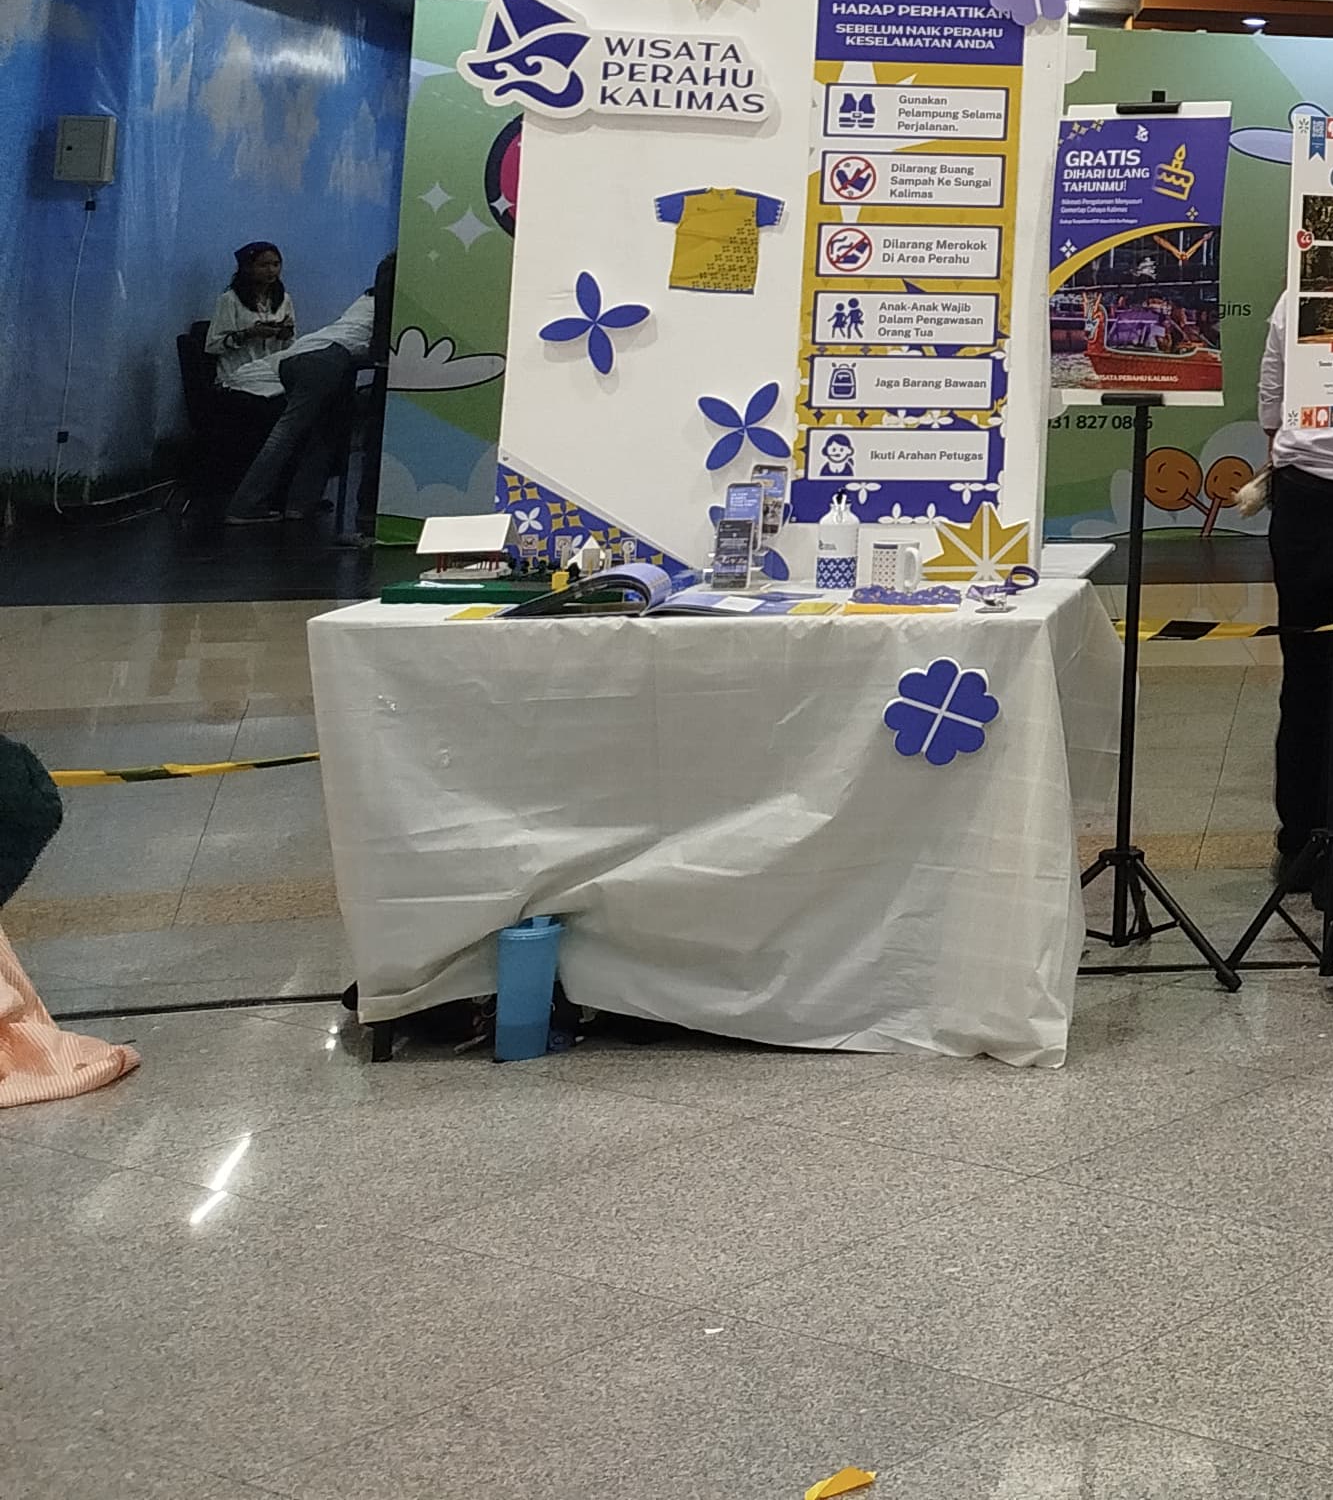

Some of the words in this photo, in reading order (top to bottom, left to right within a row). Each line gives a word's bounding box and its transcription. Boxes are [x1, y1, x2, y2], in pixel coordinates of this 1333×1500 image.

[832, 2, 895, 16] HARAP
[835, 23, 904, 35] SEBELUM
[906, 25, 940, 37] NAIK
[943, 26, 1004, 38] PERAHU
[845, 36, 952, 48] KESELAMATAN
[954, 38, 995, 50] ANDA
[604, 36, 742, 64] WISATA
[602, 62, 755, 88] PERAHU
[599, 86, 766, 114] KALIMAS
[898, 95, 948, 105] Gunakan
[897, 108, 959, 120] Pelampung
[961, 110, 1002, 120] Selama
[897, 121, 959, 133] Perjalanan.
[1065, 149, 1141, 167] GRATIS
[890, 164, 937, 175] Dilarang
[939, 165, 975, 176] Buang
[1063, 169, 1105, 180] DIHARI
[1107, 168, 1150, 179] ULANG
[890, 177, 935, 188] Sampah
[937, 177, 951, 187] Ke
[953, 177, 992, 188] Sungai
[1062, 180, 1127, 192] TAHUNMU!
[889, 189, 933, 199] Kalimas
[882, 239, 933, 251] Dilarang
[936, 239, 988, 250] Merokok
[882, 253, 895, 263] Di
[896, 254, 926, 264] Area
[928, 254, 970, 264] Perahu
[879, 302, 939, 312] Anak-Anak
[940, 302, 971, 313] Wajib
[878, 315, 913, 325] Dalam
[915, 315, 984, 327] Pengawasan
[877, 328, 911, 339] Orang
[913, 328, 934, 337] Tua
[874, 378, 900, 389] Jaga
[902, 379, 942, 389] Barang
[944, 379, 987, 388] Bawaan
[1076, 415, 1108, 429] 827
[870, 451, 895, 460] Ikuti
[898, 451, 937, 460] Arahan
[939, 451, 983, 462] Petugas
